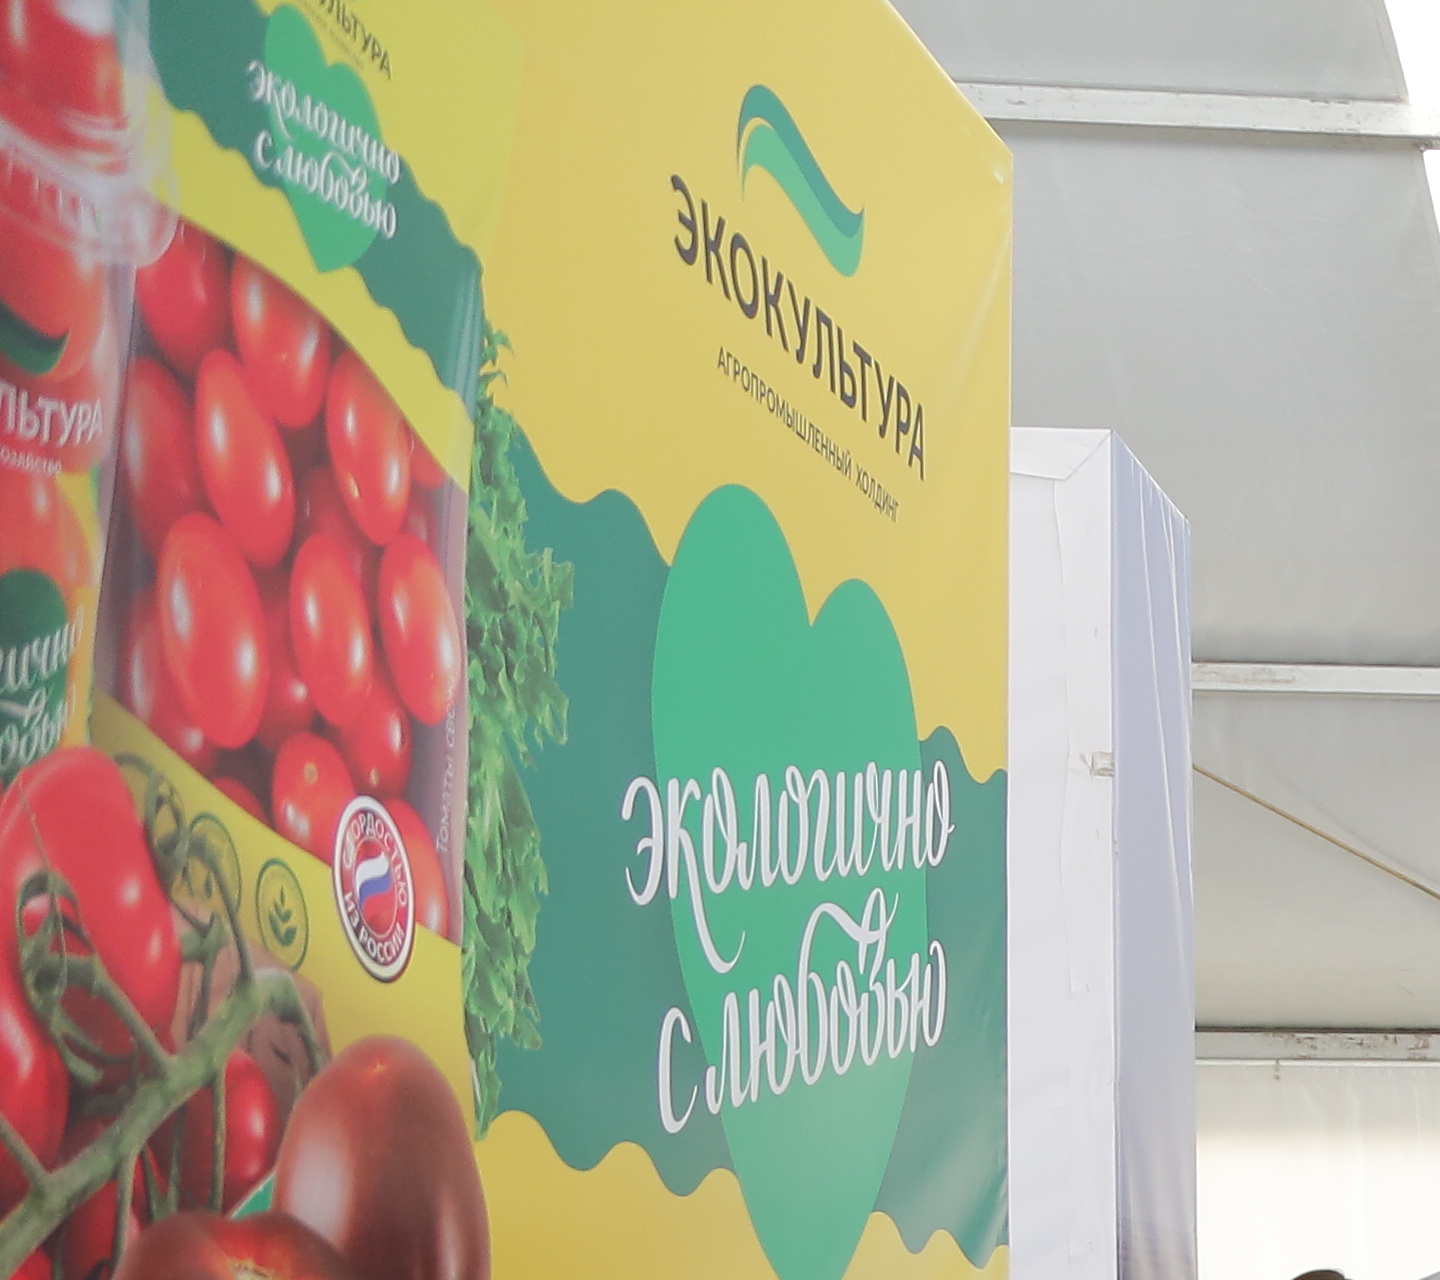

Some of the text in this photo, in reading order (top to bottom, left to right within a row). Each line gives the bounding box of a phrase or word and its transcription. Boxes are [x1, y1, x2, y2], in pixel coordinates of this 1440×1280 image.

[319, 0, 392, 80] ЛЬТУРА
[246, 60, 402, 185] экологично
[276, 145, 397, 239] любовью
[669, 173, 926, 482] ЭКОКУЛЬТУРА
[716, 346, 900, 523] АГРОПРОМЫШЛЕННЫЙ ХОЛДИНГ
[358, 920, 406, 964] РОССИИ
[621, 760, 955, 974] экологично
[705, 886, 948, 1115] любовью
